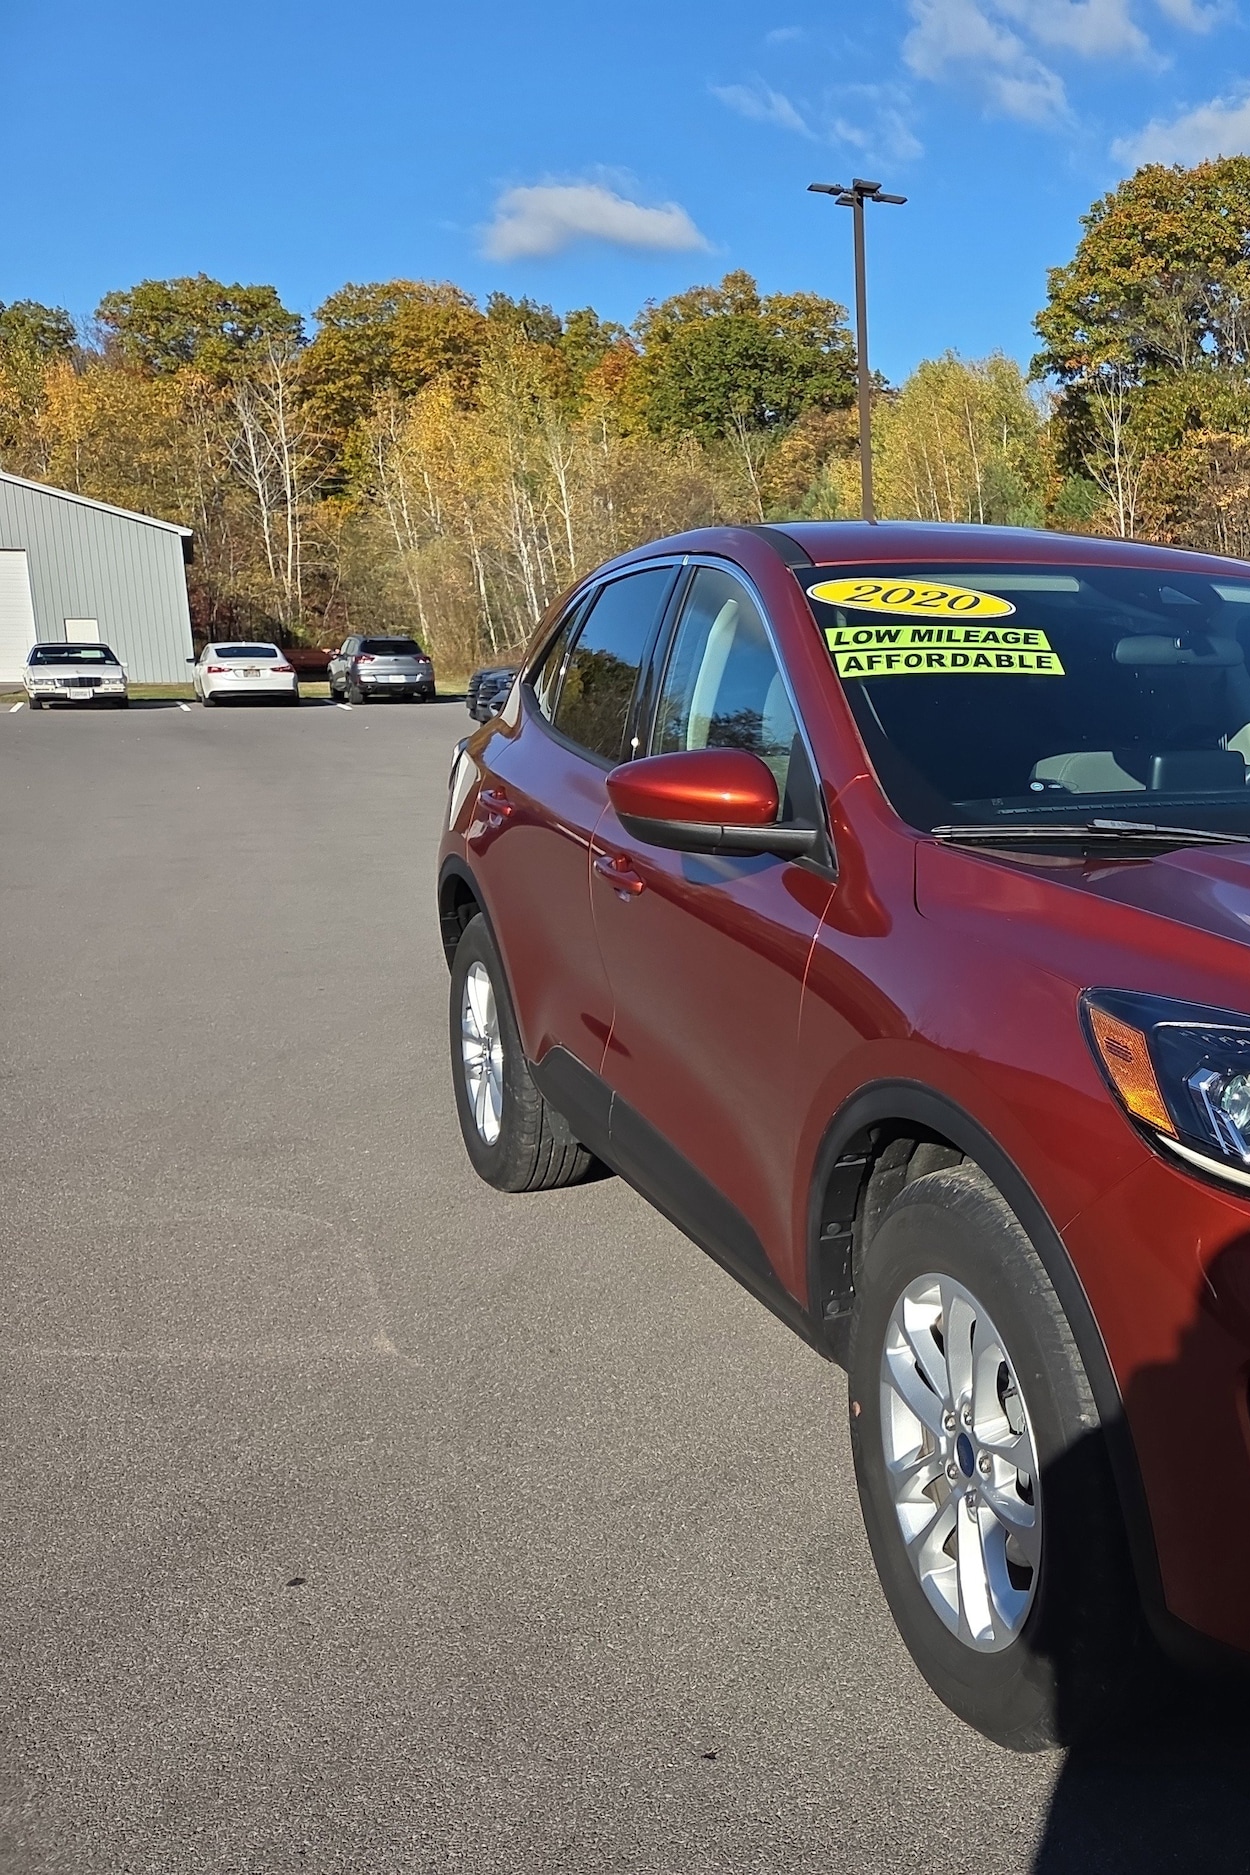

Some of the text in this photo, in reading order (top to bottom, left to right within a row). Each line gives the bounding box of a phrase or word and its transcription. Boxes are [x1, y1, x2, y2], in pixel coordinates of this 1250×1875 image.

[842, 584, 981, 611] 2020
[833, 629, 1040, 646] LOW MILEAGE
[842, 653, 1053, 672] AFFORDABLE
